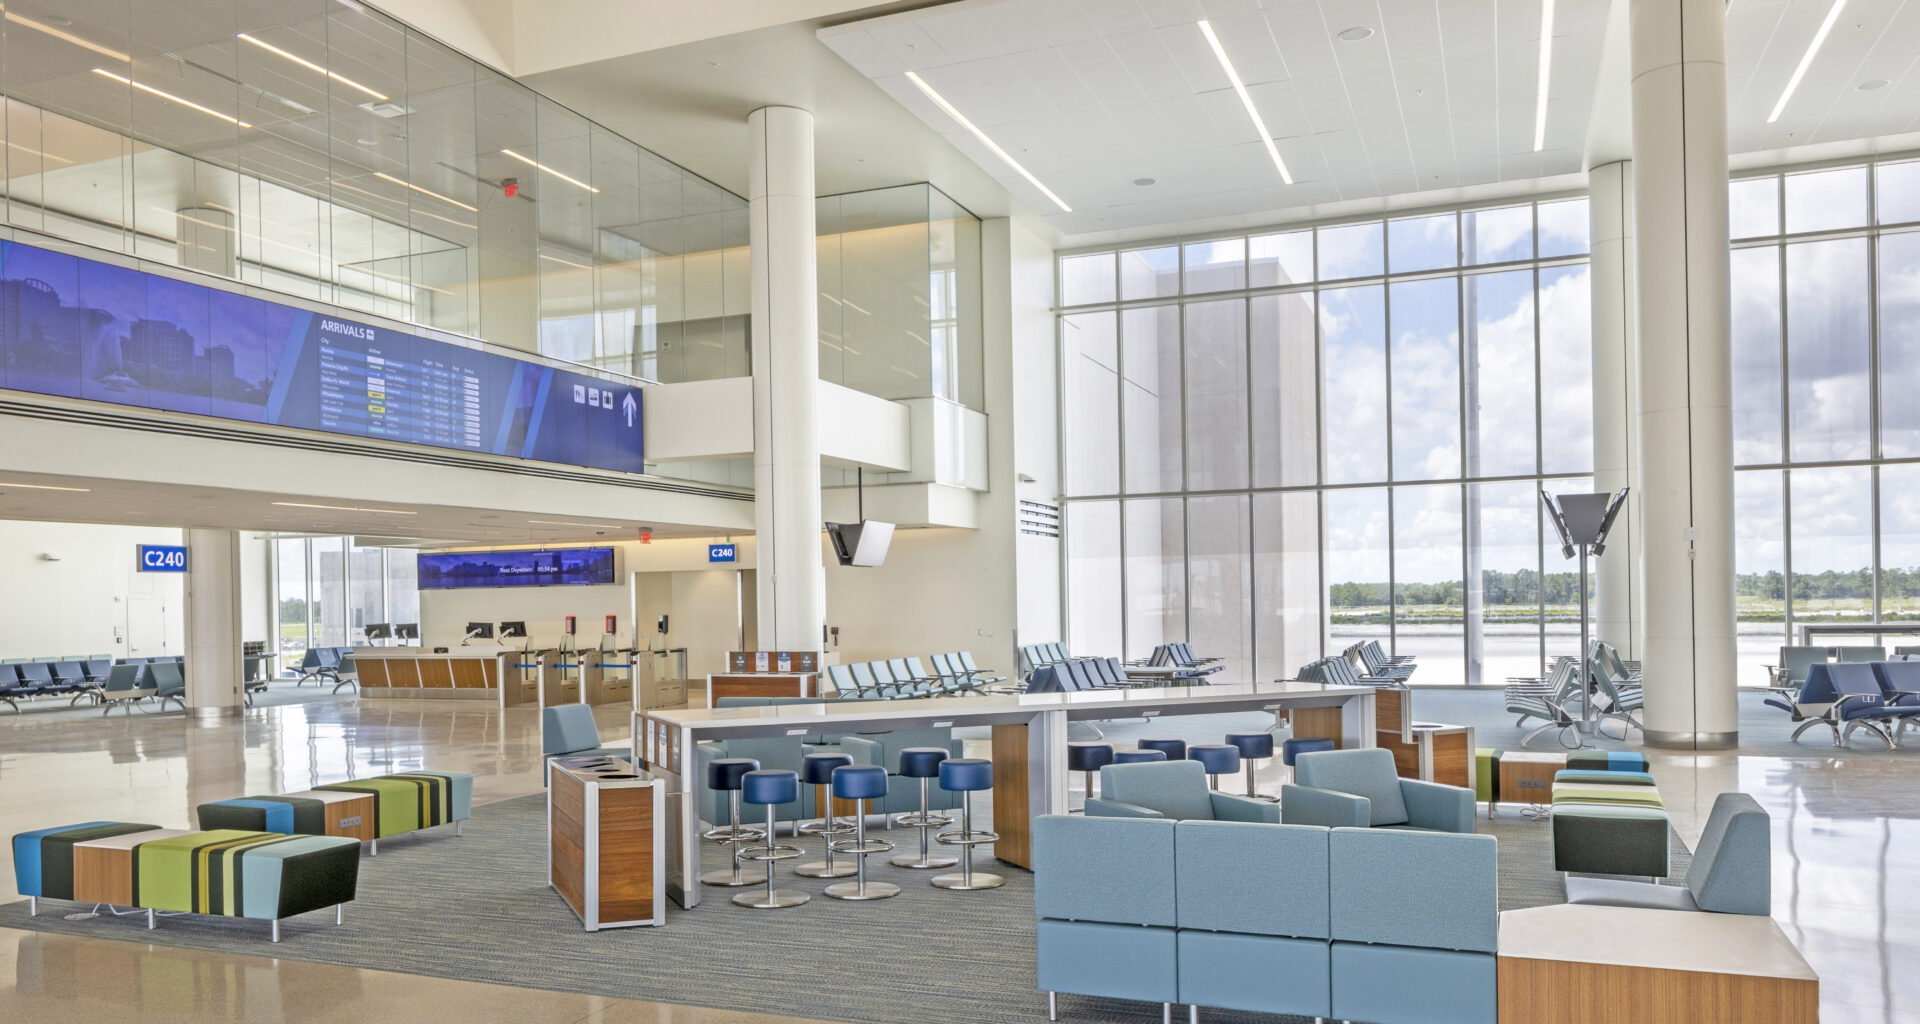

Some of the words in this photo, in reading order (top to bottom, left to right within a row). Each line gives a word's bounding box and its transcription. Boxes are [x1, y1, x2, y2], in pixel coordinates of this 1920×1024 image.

[321, 320, 365, 339] ARRIVALS
[145, 550, 184, 567] C240
[711, 548, 733, 558] C240
